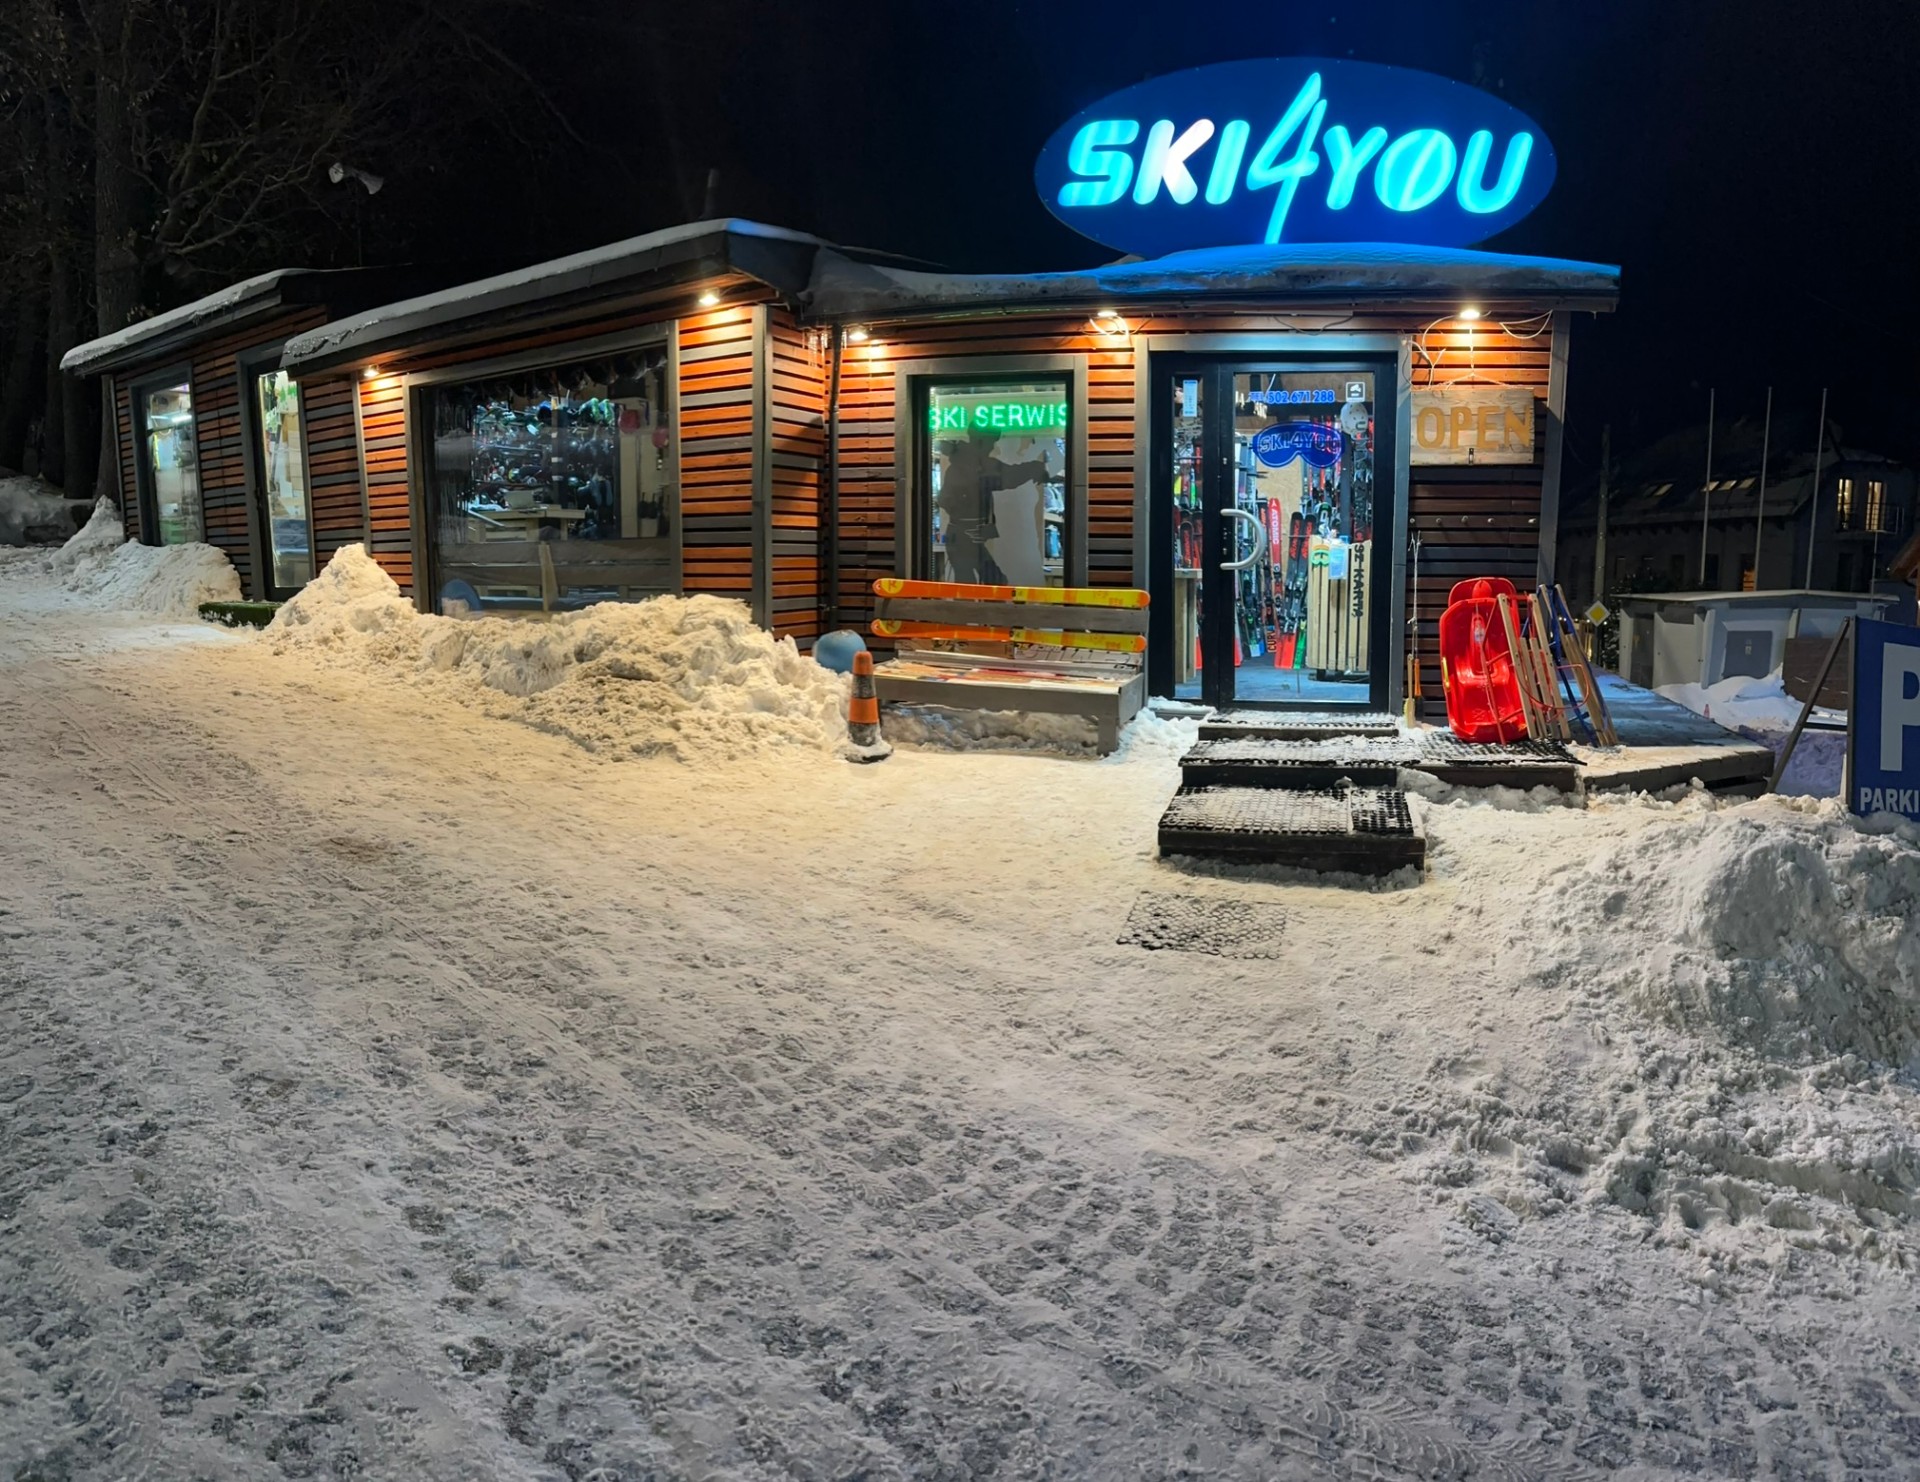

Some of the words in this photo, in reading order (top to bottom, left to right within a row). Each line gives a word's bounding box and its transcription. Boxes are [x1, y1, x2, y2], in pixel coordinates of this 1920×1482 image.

[1057, 72, 1534, 245] SKI4YOU
[1267, 390, 1289, 404] 502
[1290, 390, 1311, 404] 671
[1312, 389, 1335, 404] 288
[975, 404, 1067, 427] SERWIS
[1417, 405, 1531, 450] OPEN
[1271, 508, 1280, 545] ATOMIC
[1880, 642, 1920, 771] P
[1860, 787, 1919, 813] PARKI
